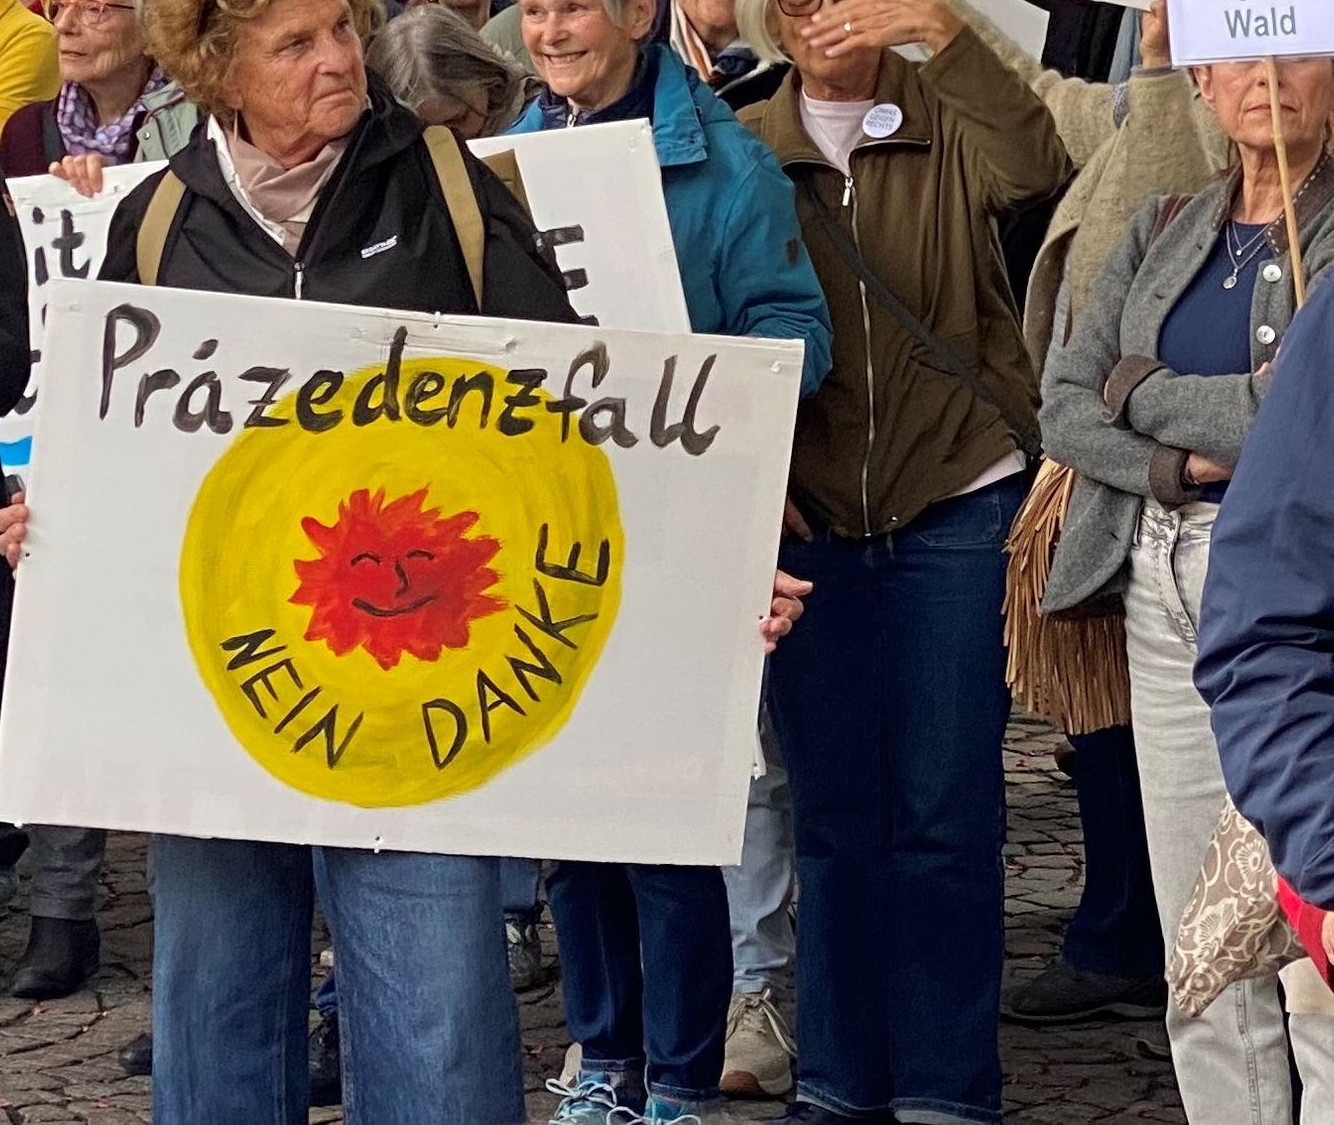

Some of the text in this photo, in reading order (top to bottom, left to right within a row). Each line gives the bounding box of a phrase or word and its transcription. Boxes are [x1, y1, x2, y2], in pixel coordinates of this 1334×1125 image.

[1224, 5, 1297, 39] Wald
[219, 522, 611, 772] NEIN DANKE
